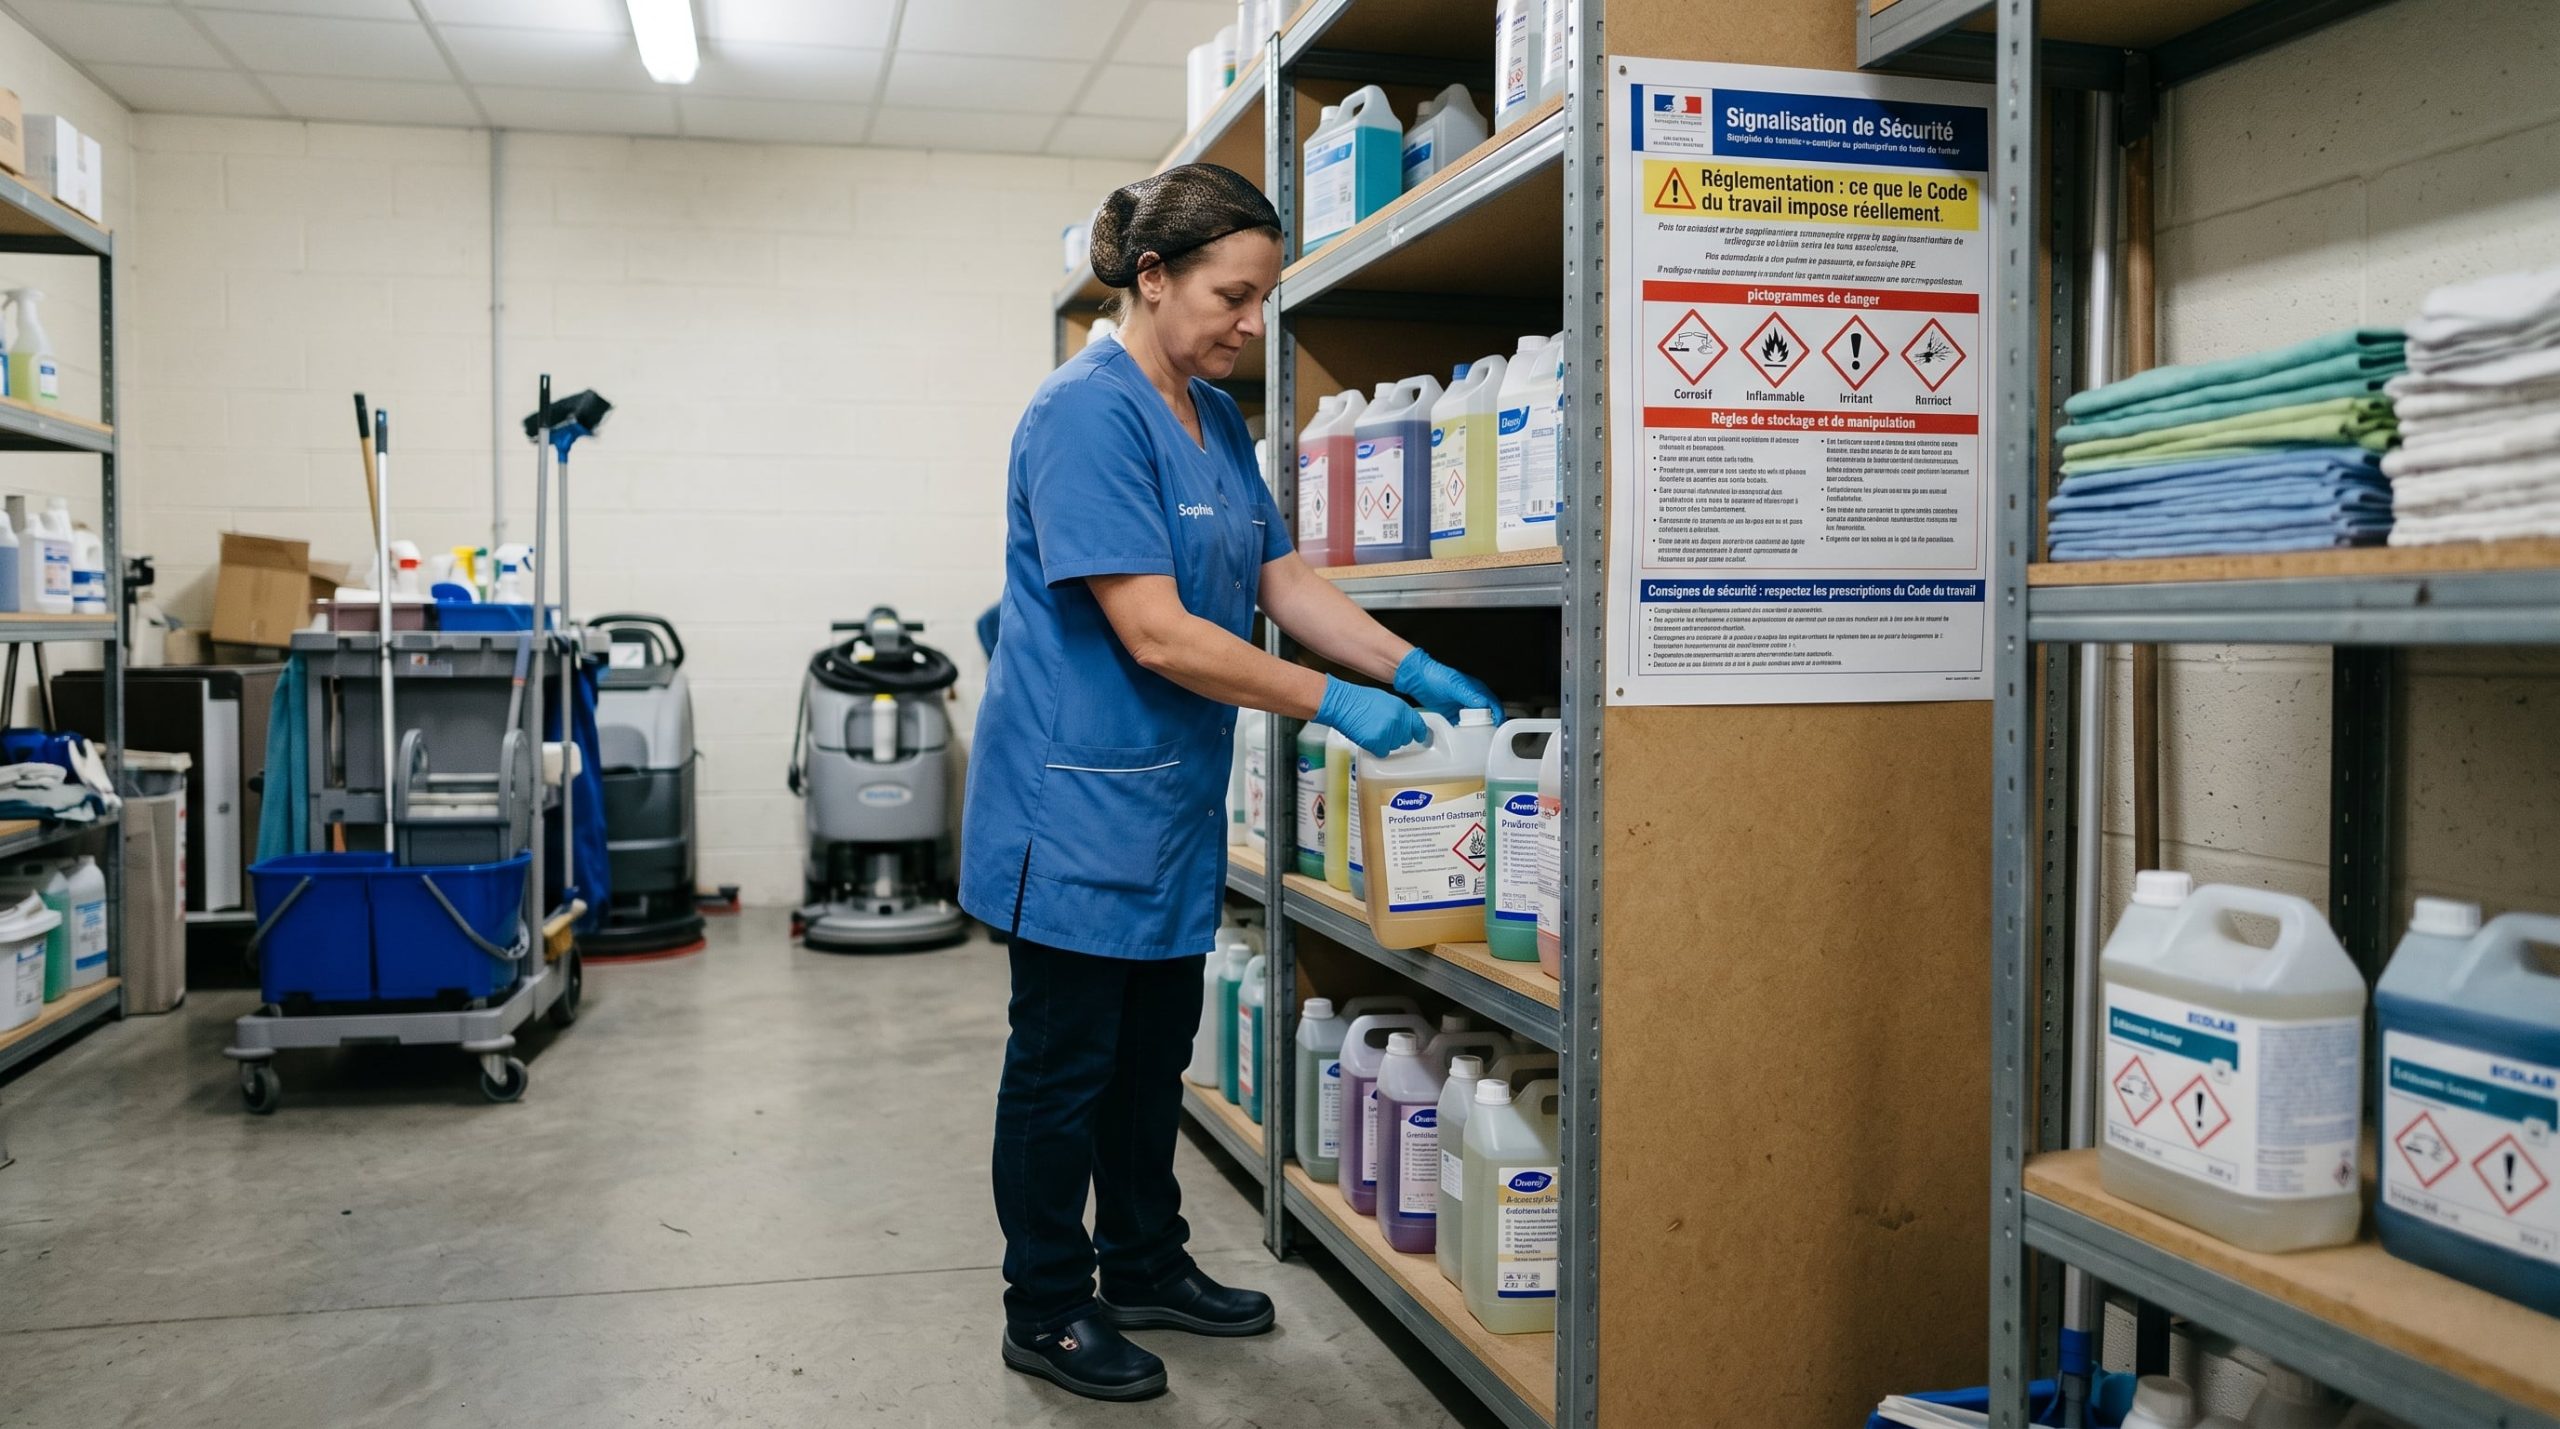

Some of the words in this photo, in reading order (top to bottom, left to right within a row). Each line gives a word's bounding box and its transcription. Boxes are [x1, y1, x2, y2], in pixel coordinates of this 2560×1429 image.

[1726, 106, 1846, 134] Signalisation
[1852, 116, 1874, 136] de
[1879, 117, 1954, 142] Sécurité
[1702, 169, 1833, 193] Réglementation
[1849, 181, 1868, 195] ce
[1873, 183, 1903, 200] que
[1909, 181, 1922, 198] le
[1927, 182, 1968, 201] Code
[1702, 193, 1722, 210] du
[1728, 195, 1781, 214] travail
[1788, 197, 1848, 219] impose
[1853, 200, 1944, 222] réellement.
[1747, 289, 1825, 306] pictogrammes
[1828, 292, 1842, 304] de
[1843, 292, 1880, 307] danger
[1674, 388, 1713, 400] Corrosif
[1746, 391, 1805, 402] Inflammable
[1839, 393, 1873, 404] Irritant
[1711, 411, 1749, 427] Règles
[1751, 413, 1764, 425] de
[1767, 414, 1815, 429] stockage
[1818, 415, 1829, 427] et
[1831, 415, 1845, 427] de
[1847, 416, 1915, 430] manipulation
[1648, 584, 1700, 599] Consignes
[1702, 584, 1715, 596] de
[1717, 584, 1757, 597] sécurité
[1764, 585, 1811, 598] respectez
[1813, 584, 1827, 596] les
[1829, 584, 1891, 598] prescriptions
[1893, 584, 1905, 596] du
[1907, 584, 1931, 596] Code
[1933, 584, 1944, 596] du
[1946, 584, 1976, 597] travail
